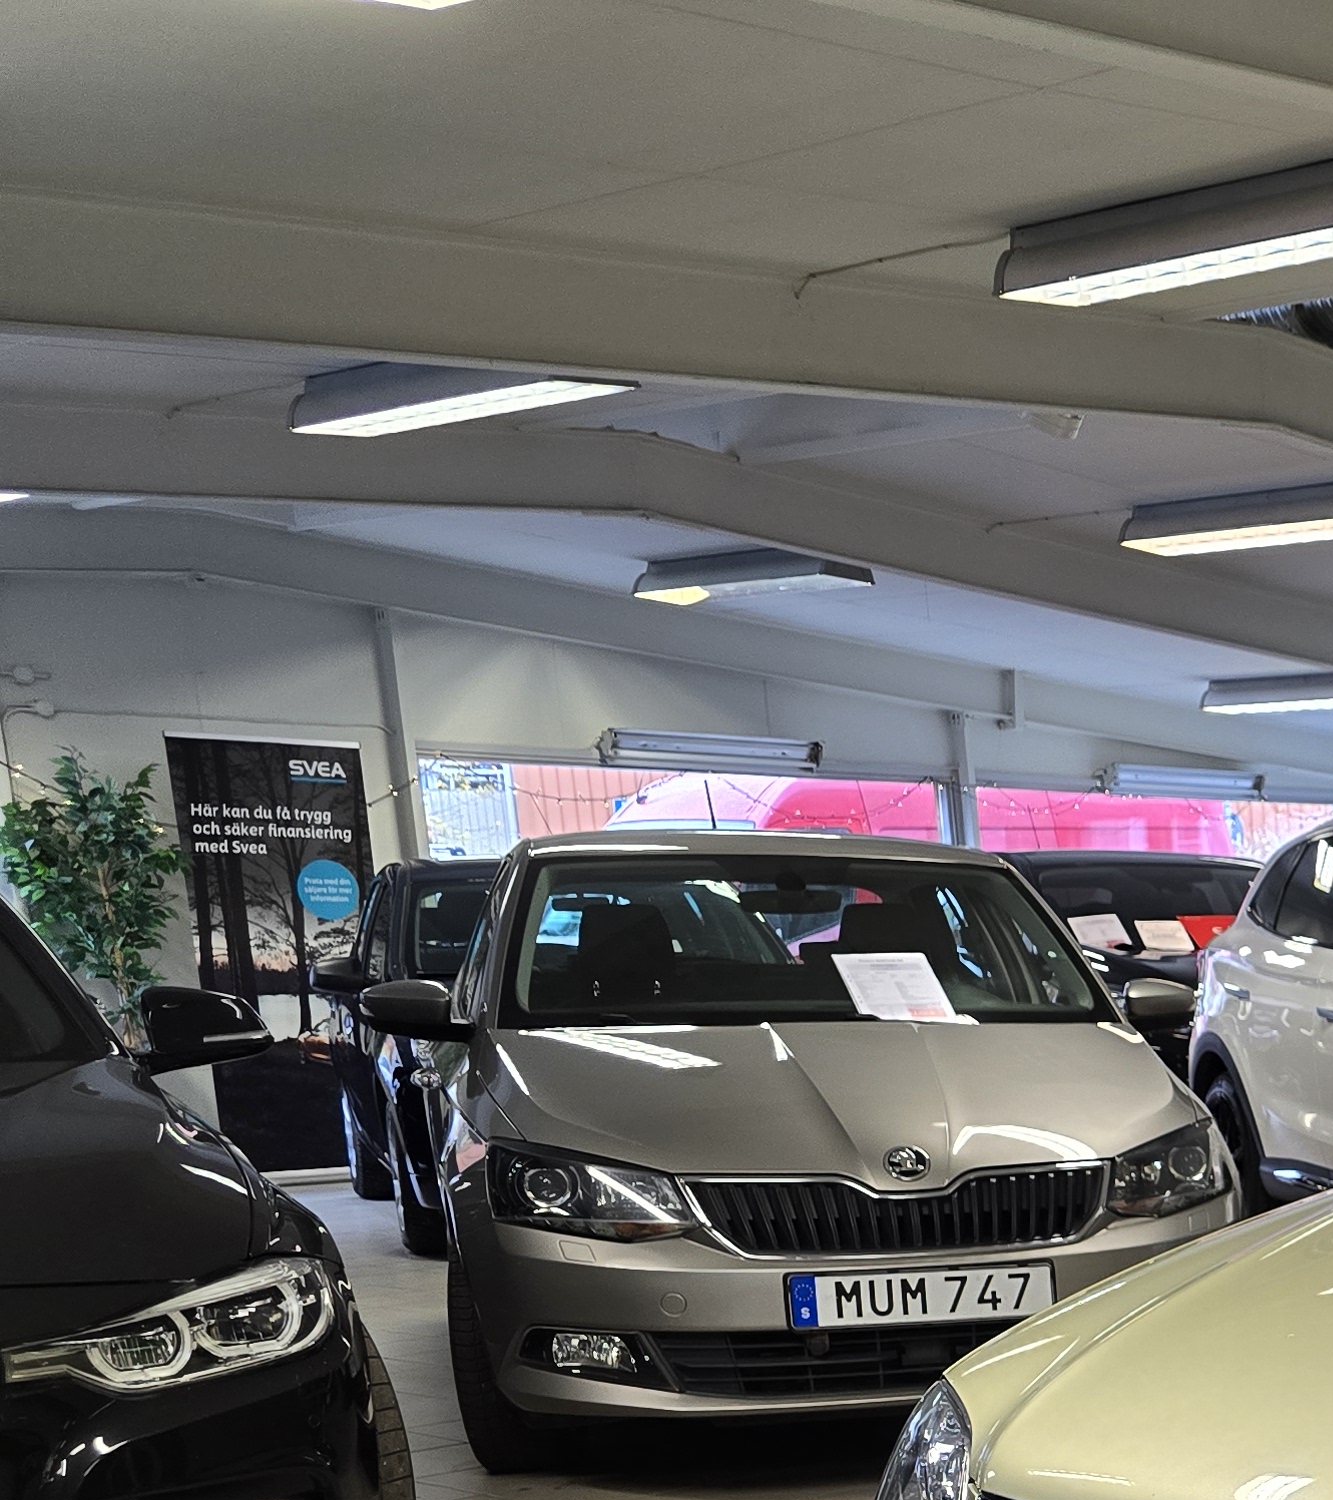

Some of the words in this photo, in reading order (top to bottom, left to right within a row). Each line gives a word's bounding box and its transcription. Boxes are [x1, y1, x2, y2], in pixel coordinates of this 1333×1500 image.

[288, 759, 347, 778] SVEA
[190, 803, 219, 817] Här
[222, 804, 250, 819] kan
[253, 805, 273, 820] du
[276, 806, 291, 821] få
[294, 808, 331, 824] trygg
[192, 822, 221, 836] och
[224, 823, 264, 837] säker
[268, 823, 352, 843] finansiering
[194, 840, 229, 854] med
[232, 840, 268, 855] Svea
[834, 1277, 928, 1319] MUM
[944, 1272, 1031, 1313] 747
